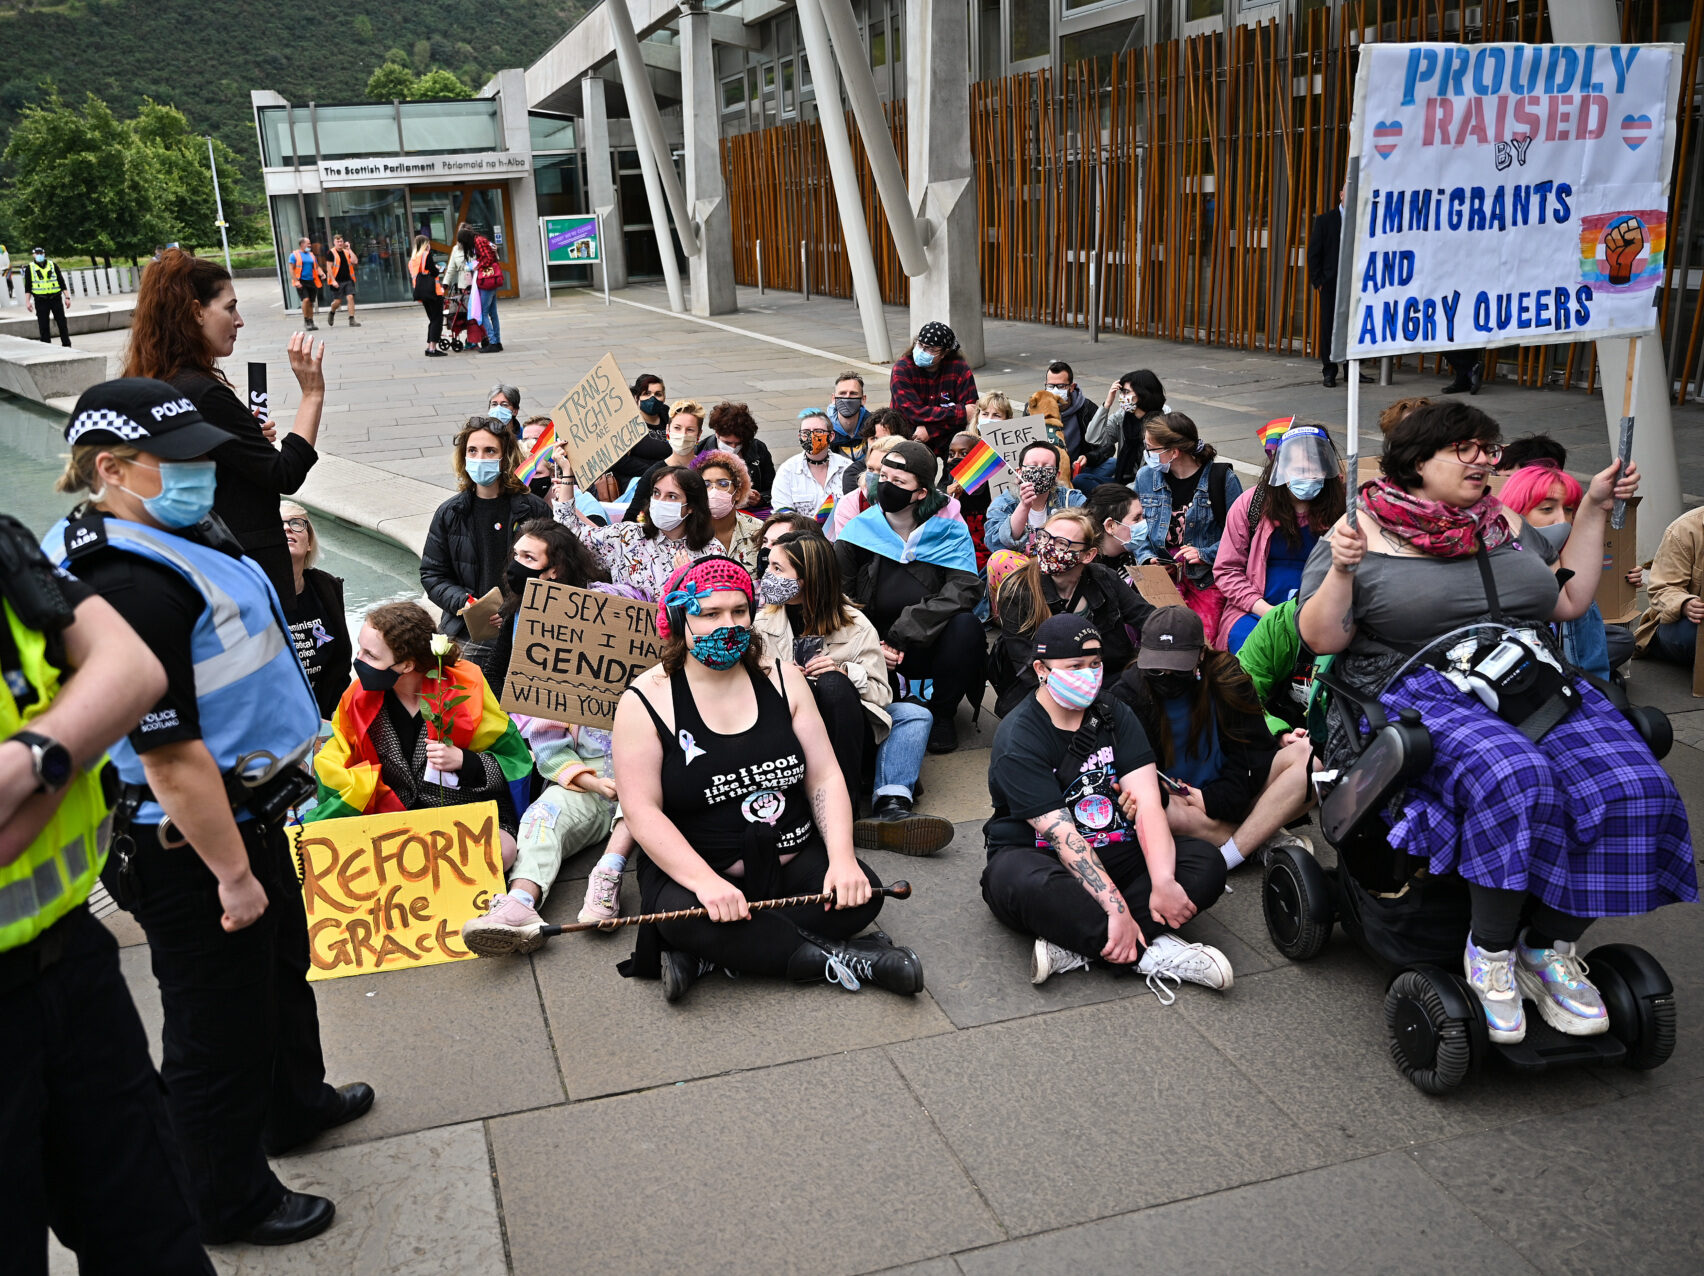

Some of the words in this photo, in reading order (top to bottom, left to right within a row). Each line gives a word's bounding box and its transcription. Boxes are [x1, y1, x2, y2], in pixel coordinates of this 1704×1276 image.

[1400, 45, 1641, 107] PROUDLY
[1422, 93, 1609, 149] RAISED
[324, 167, 341, 176] The
[344, 164, 381, 176] Scottish
[383, 162, 435, 174] Parliament
[486, 160, 497, 169] na
[498, 157, 526, 168] h-Alba
[1494, 136, 1532, 171] BY
[1361, 250, 1416, 294] AND
[1358, 289, 1461, 345] ANGRY
[1473, 284, 1594, 334] QUEERS
[151, 398, 198, 422] POLIC
[558, 365, 610, 424] TRANS
[569, 386, 624, 449] RIGHTS
[595, 425, 610, 443] ARE
[575, 443, 614, 489] HUMAN
[610, 414, 648, 458] RIGHTS
[524, 582, 561, 613] IF
[564, 592, 609, 626] SEX
[288, 618, 323, 632] eminism
[525, 619, 584, 644] THEN
[598, 633, 617, 648] I
[511, 681, 567, 712] WITH
[704, 781, 740, 798] like
[742, 775, 752, 786] I
[753, 763, 805, 783] belong
[712, 773, 737, 786] Do
[739, 767, 749, 778] I
[750, 754, 799, 775] LOOK
[707, 794, 727, 805] in
[728, 785, 758, 798] the
[301, 815, 499, 915] REFORM
[367, 884, 435, 936] the
